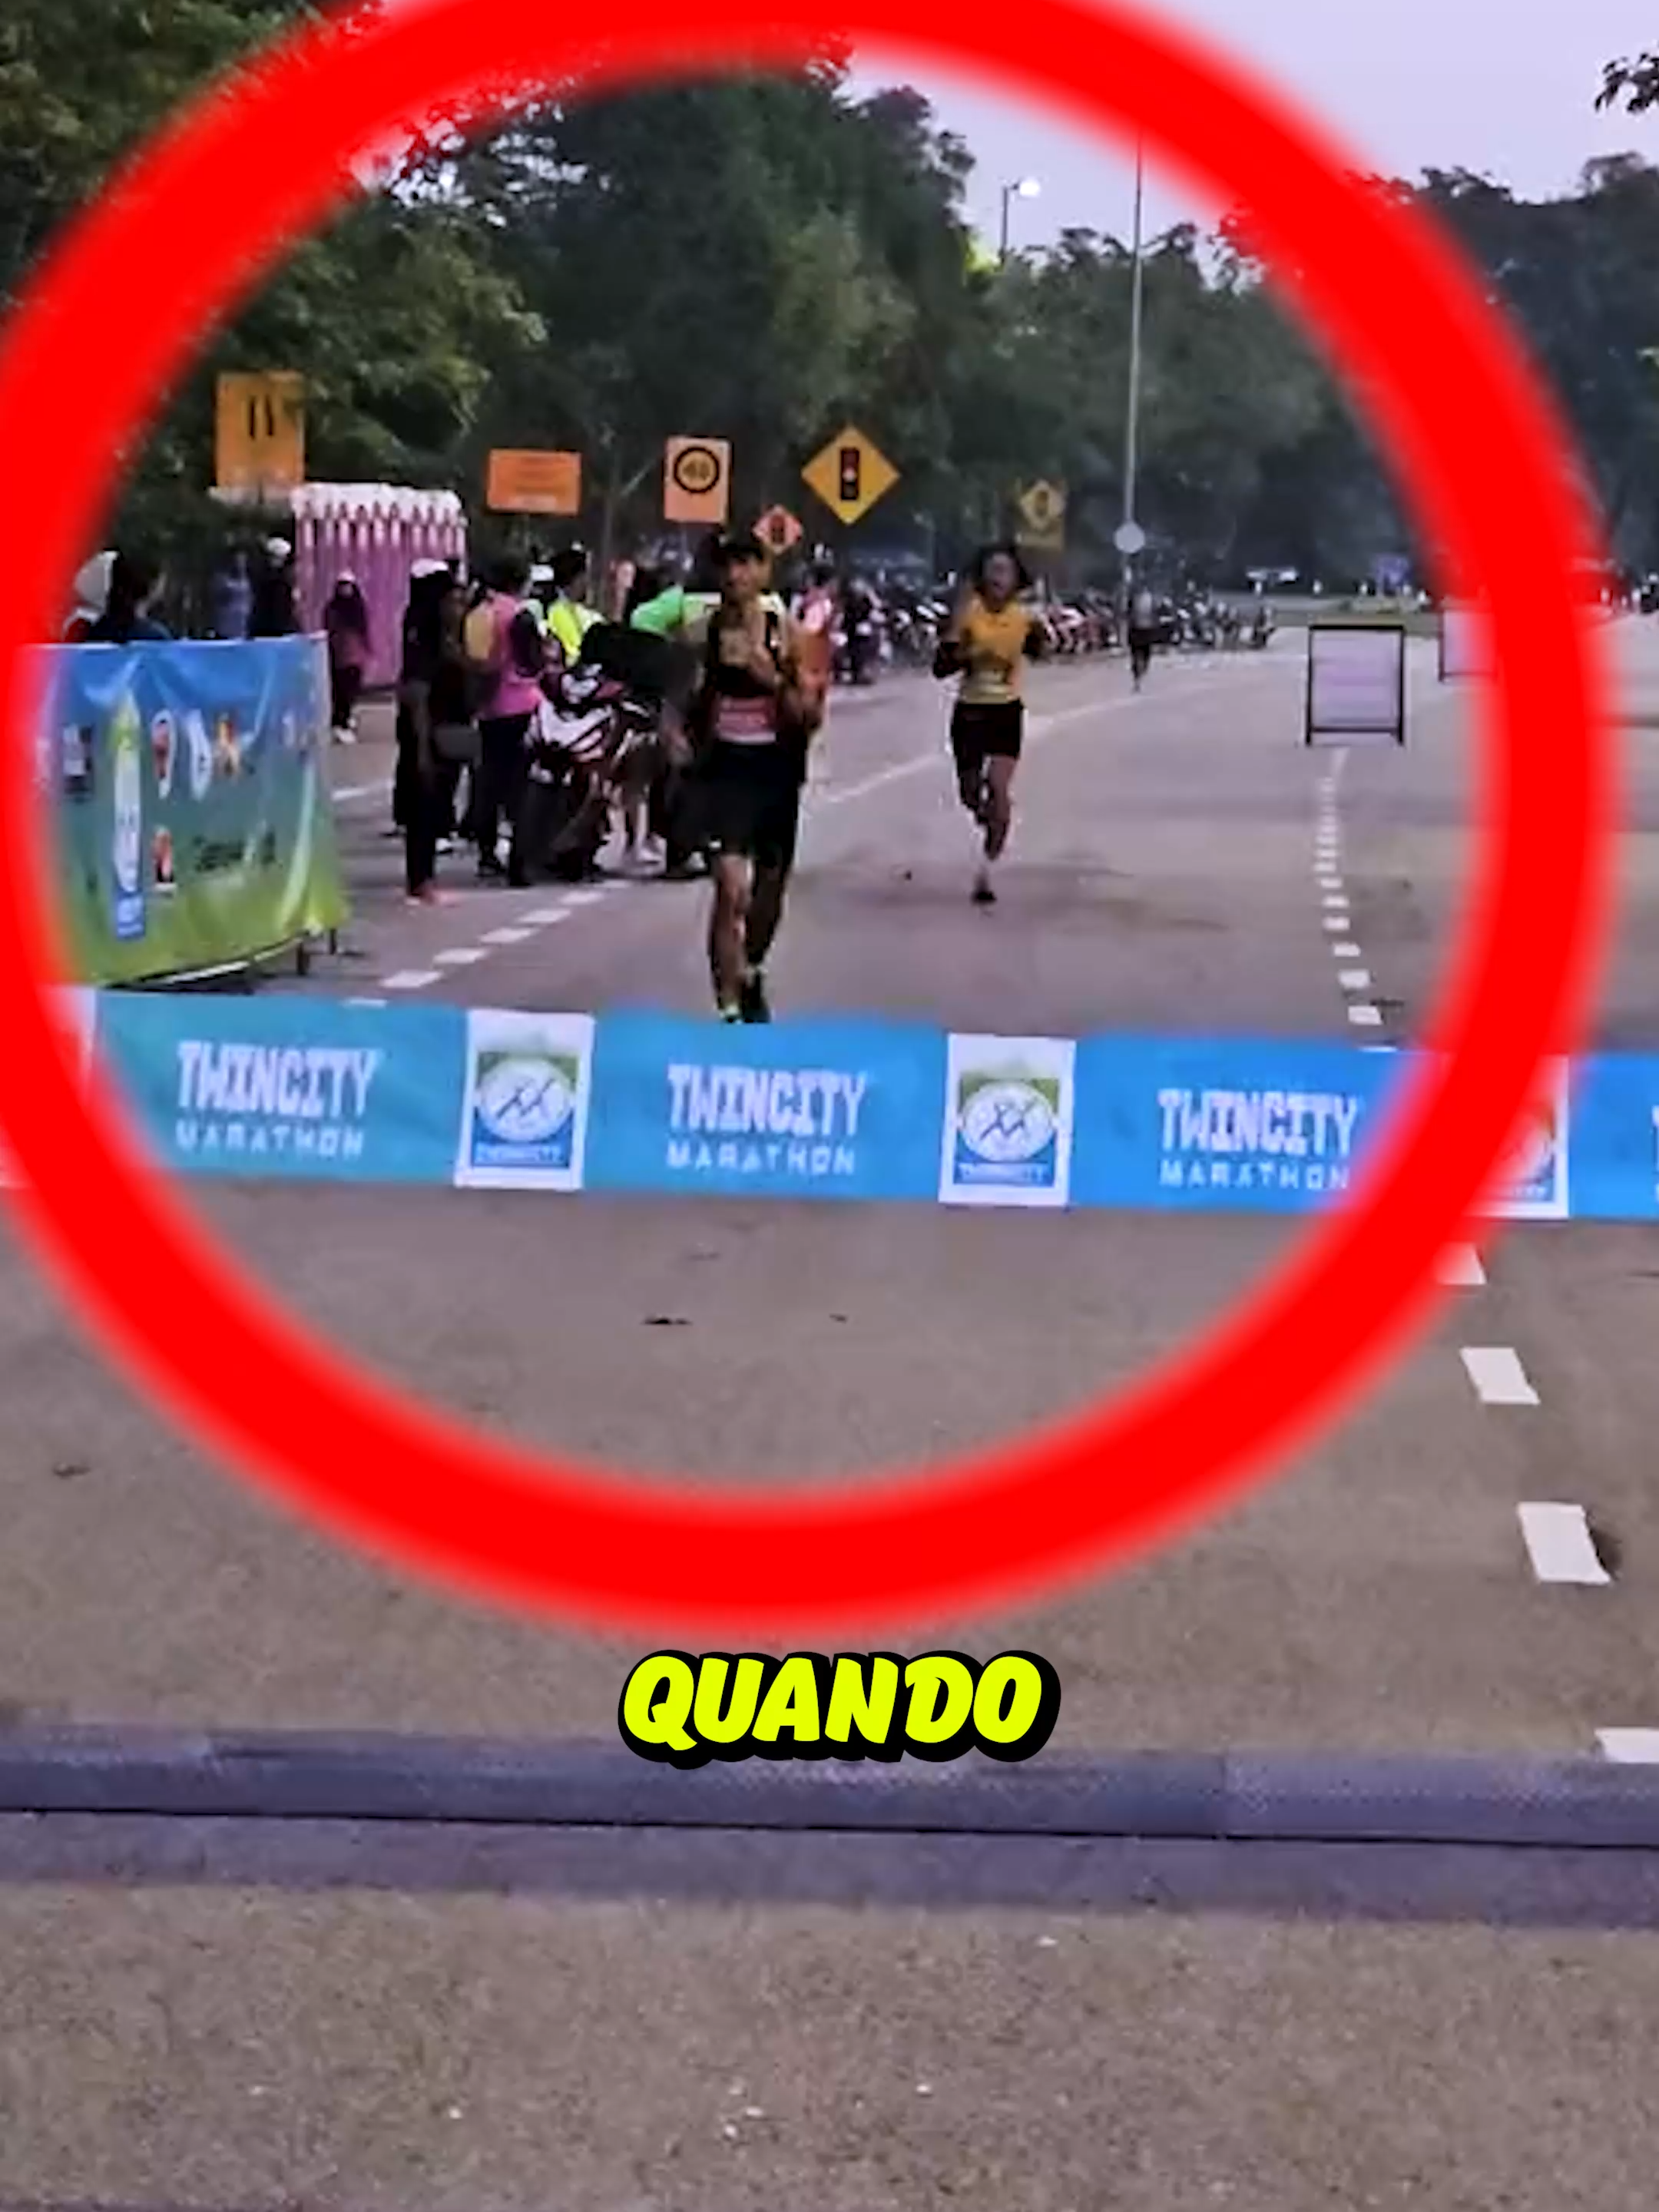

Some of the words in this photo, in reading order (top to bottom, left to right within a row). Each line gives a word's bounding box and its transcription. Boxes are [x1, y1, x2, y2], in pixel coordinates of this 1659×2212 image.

[177, 1040, 382, 1118] TWINCITY
[667, 1063, 868, 1137] TWINCITY
[176, 1119, 364, 1156] MARATHON
[1157, 1088, 1358, 1157] TWINCITY
[666, 1139, 856, 1175] MARATHON
[1159, 1159, 1350, 1190] MARATHON
